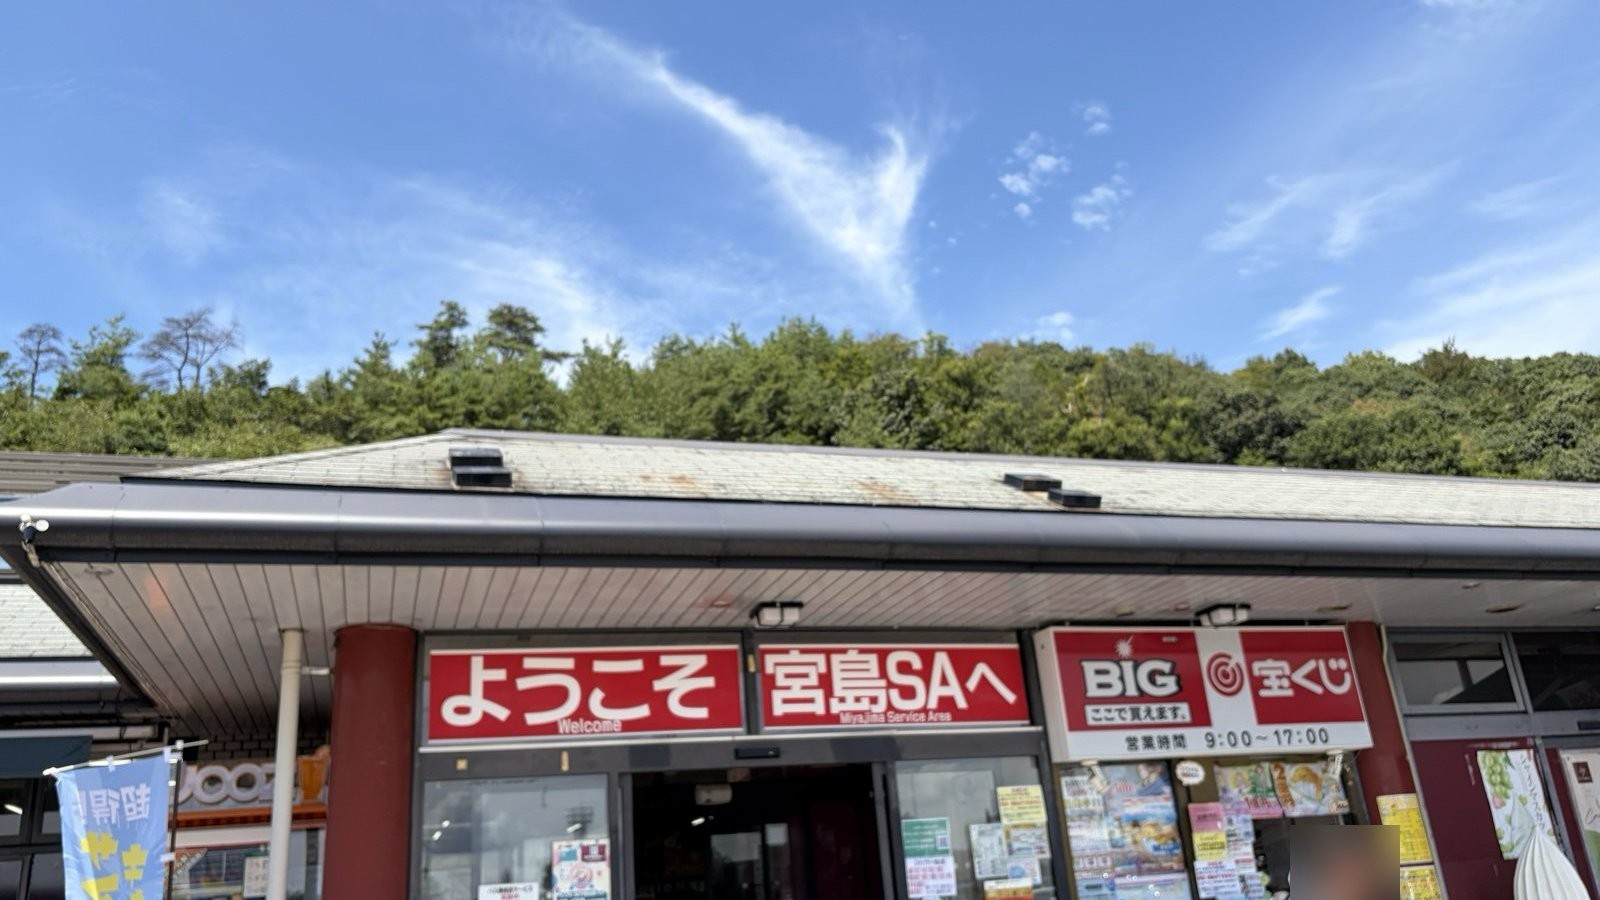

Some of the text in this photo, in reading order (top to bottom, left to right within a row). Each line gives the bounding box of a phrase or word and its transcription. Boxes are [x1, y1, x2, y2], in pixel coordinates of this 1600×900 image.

[764, 649, 1017, 716] 宮島SAへ
[1252, 658, 1352, 697] 宝くじ
[441, 655, 716, 726] ようこそ
[839, 710, 952, 724] Miyajima Service Area
[1090, 705, 1187, 723] ここで買えます。
[557, 718, 622, 734] Welcome
[1125, 735, 1187, 751] 営業時間
